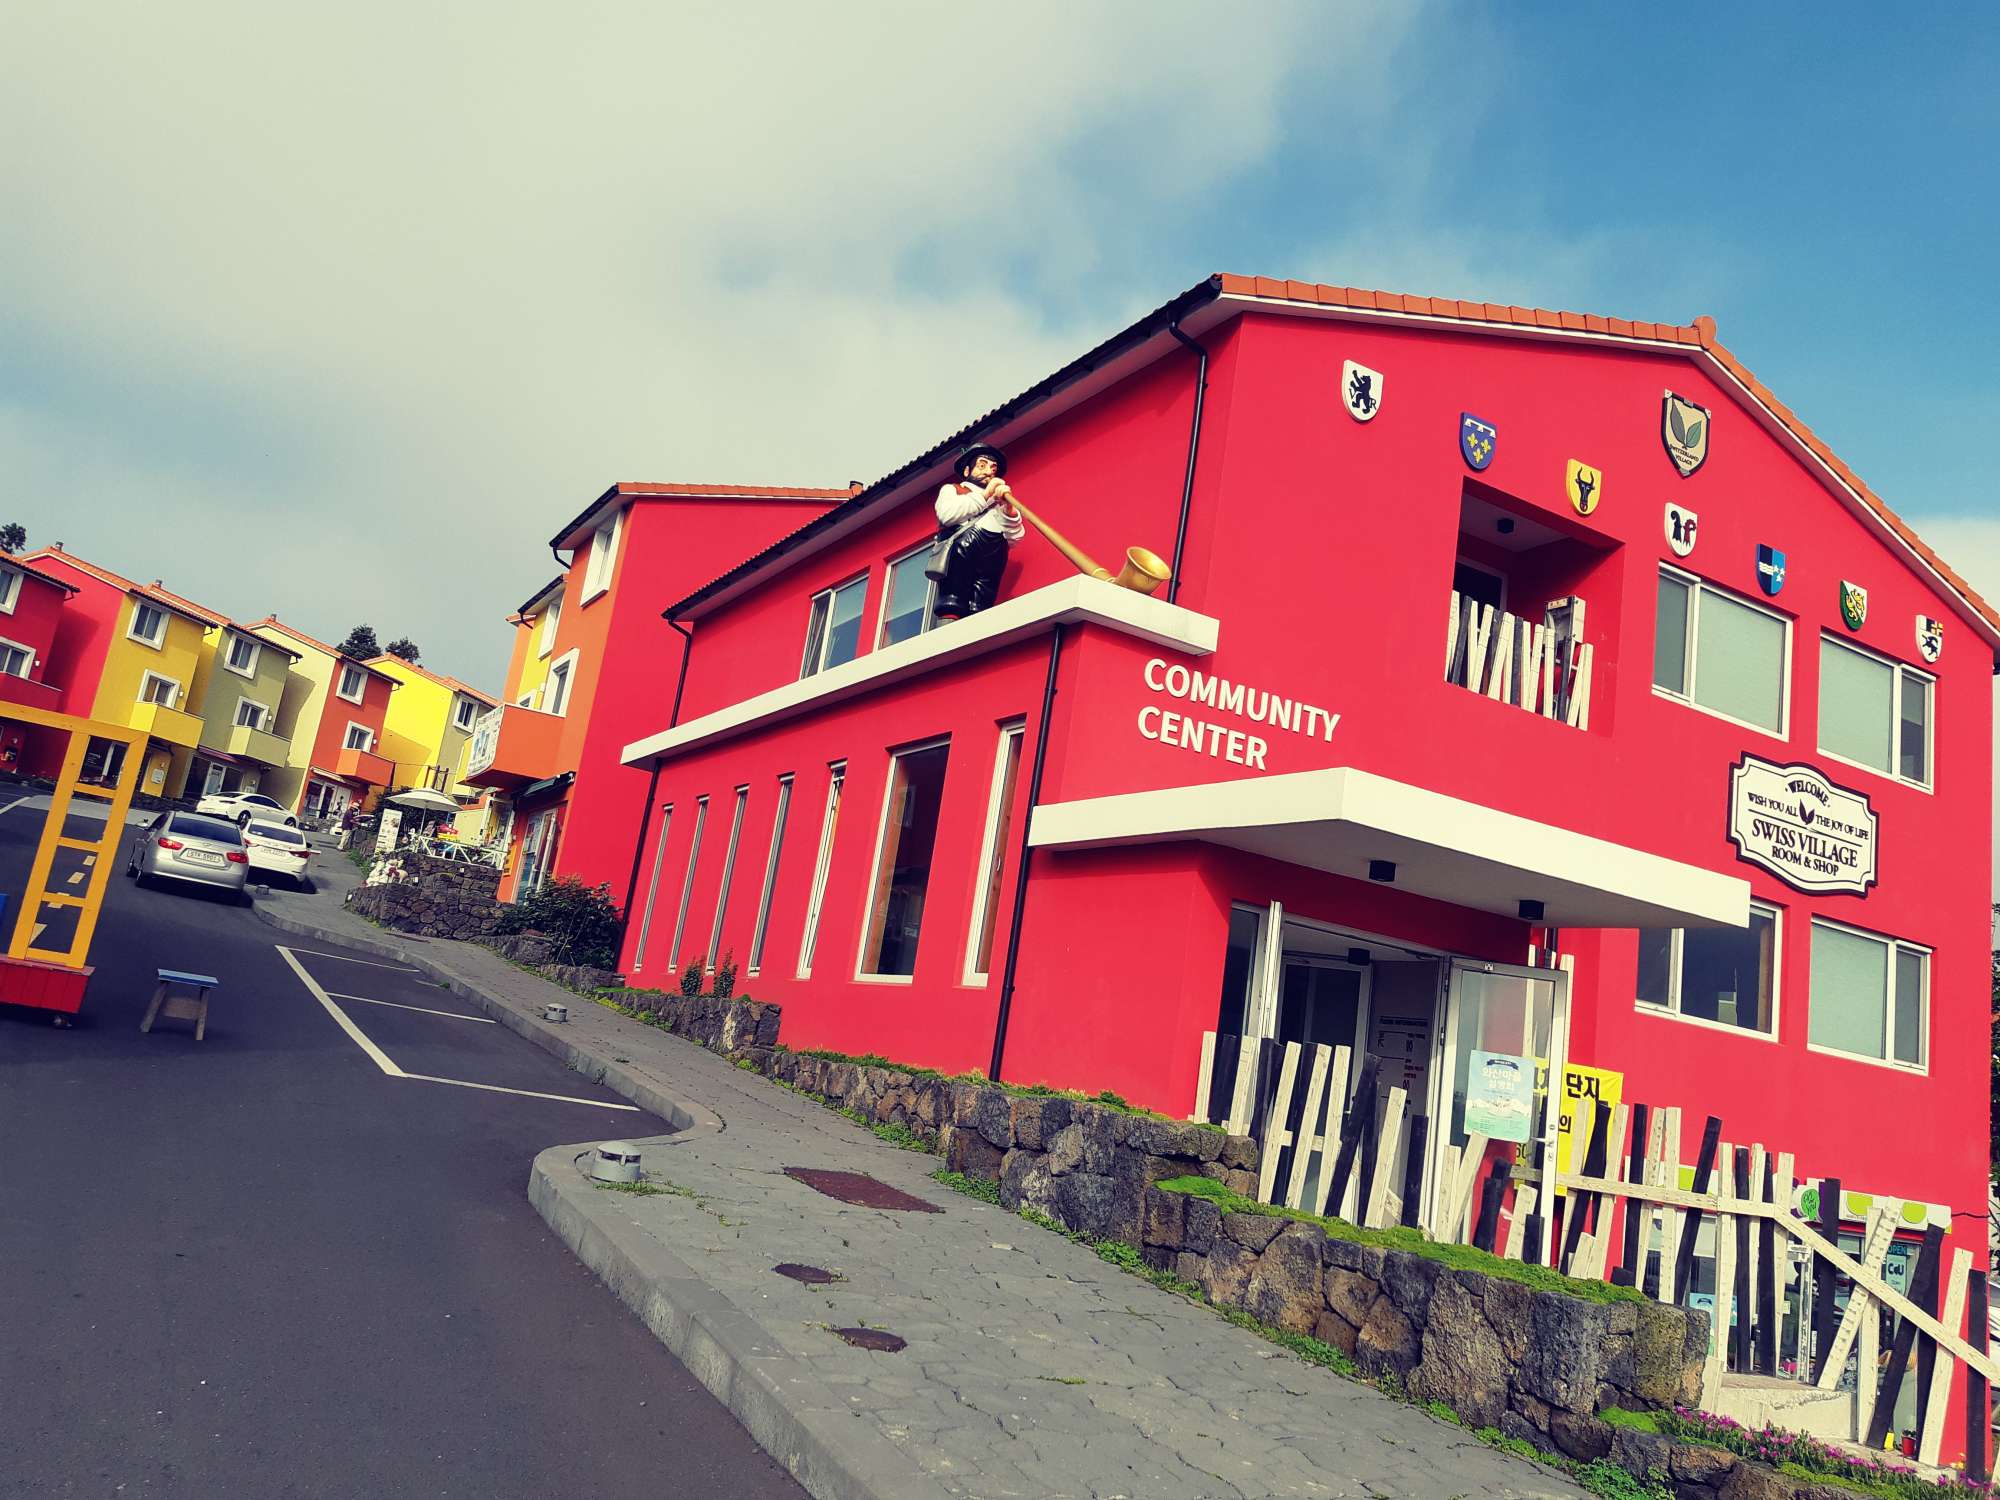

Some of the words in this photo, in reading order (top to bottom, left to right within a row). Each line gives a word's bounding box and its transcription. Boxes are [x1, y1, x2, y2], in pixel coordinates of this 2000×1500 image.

[1144, 658, 1341, 742] COMMUNITY
[1137, 706, 1268, 771] CENTER
[1788, 780, 1830, 806] WELCOME
[1747, 792, 1767, 807] WISH
[1768, 799, 1784, 813] YOU
[1785, 805, 1799, 817] ALL
[1815, 814, 1831, 828] THE
[1830, 820, 1844, 832] JOY
[1844, 824, 1855, 836] OF
[1855, 828, 1869, 840] LIFE
[1752, 818, 1796, 848] SWISS
[1798, 832, 1858, 868] VILLAGE
[1772, 845, 1802, 865] ROOM
[1803, 855, 1812, 869] &
[1813, 859, 1839, 876] SHOP
[1566, 1072, 1600, 1101] 단지
[1888, 1245, 1907, 1257] OPEN
